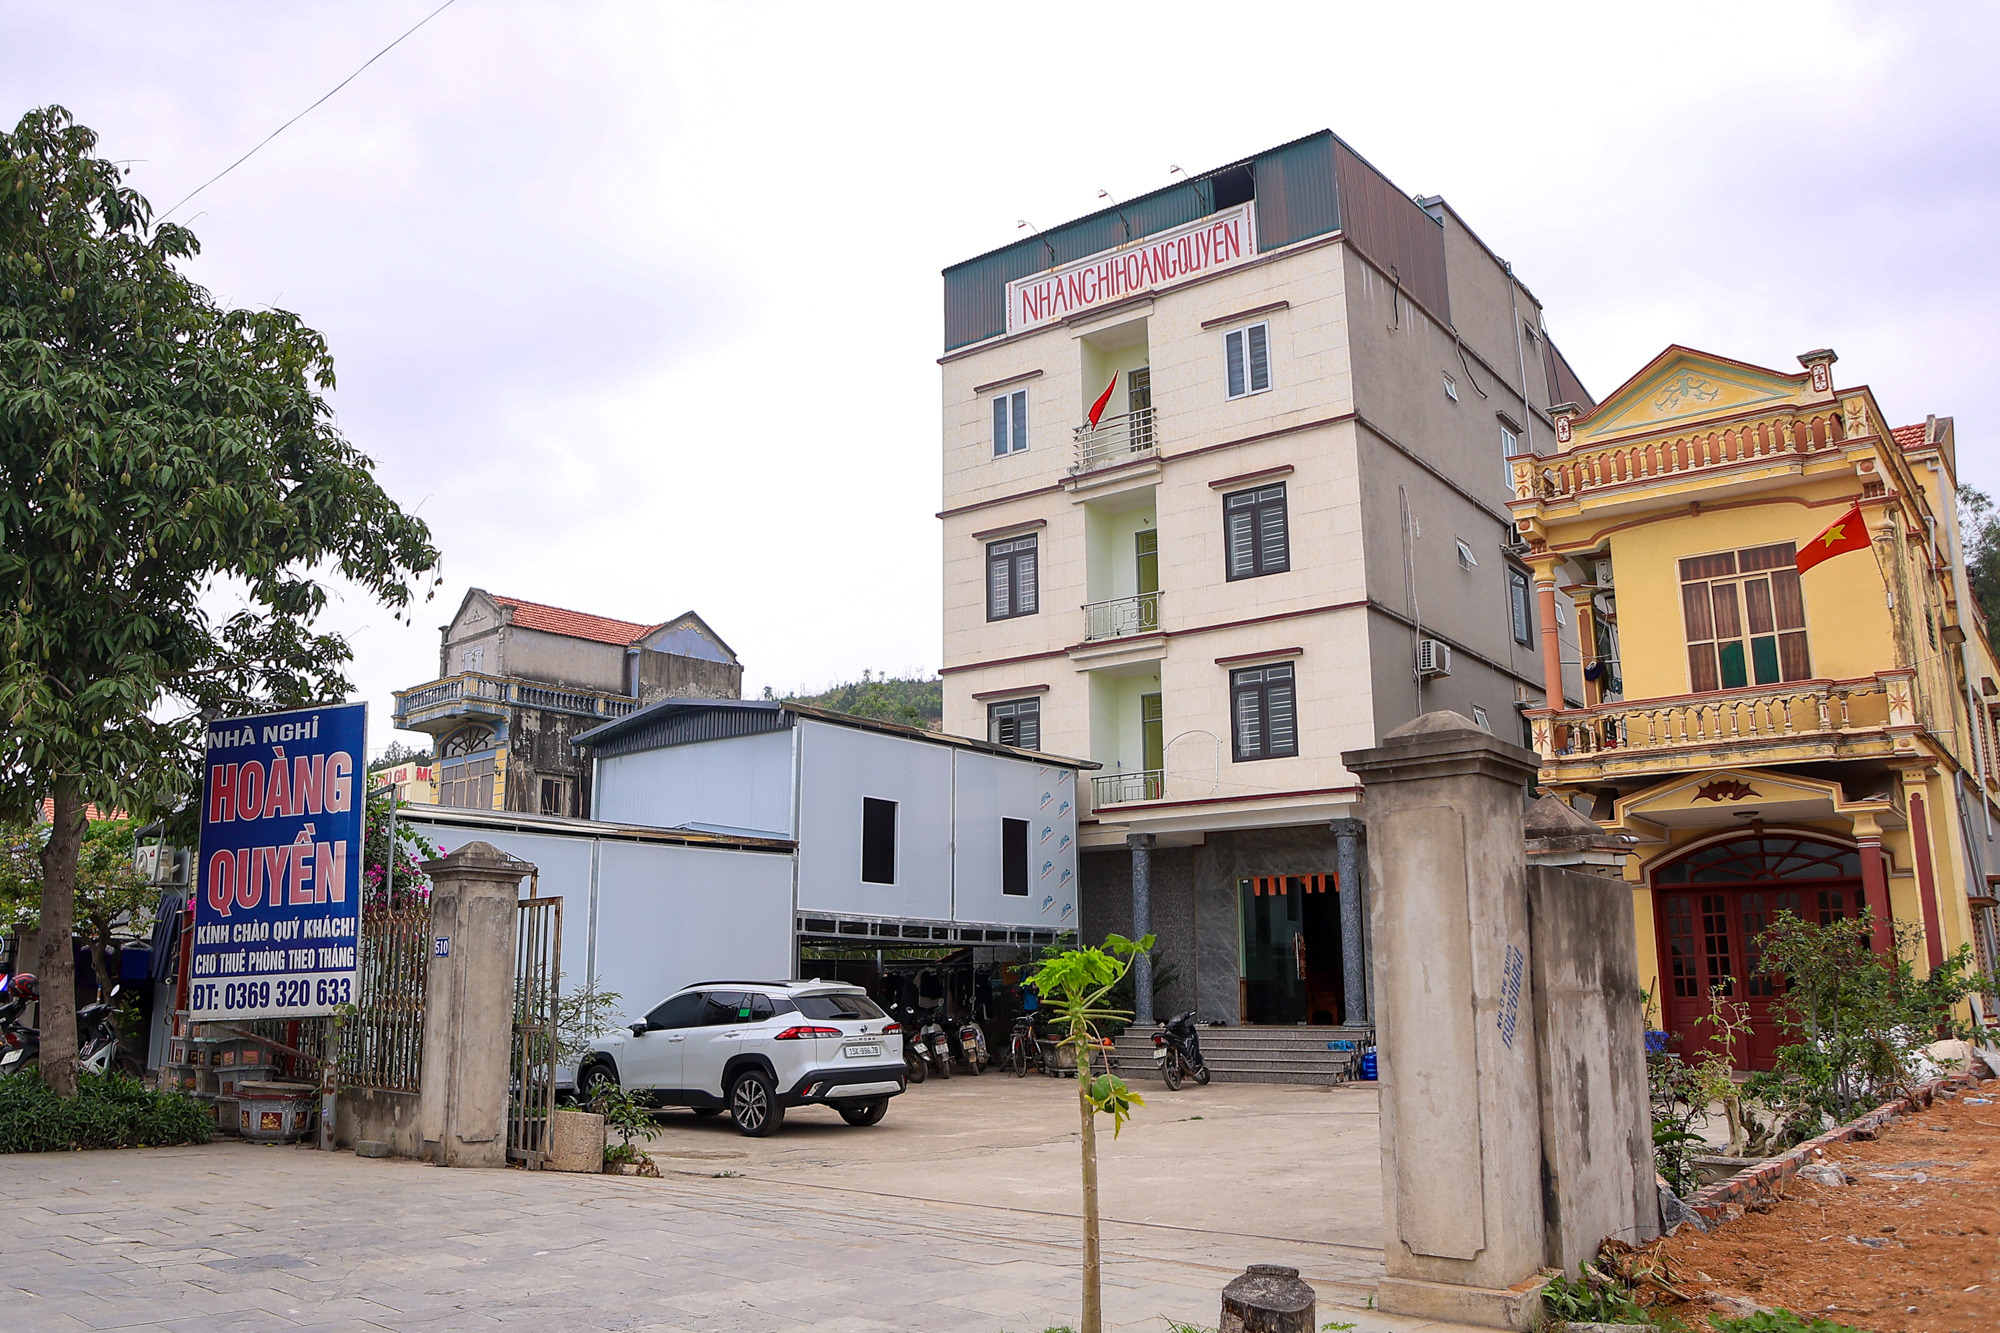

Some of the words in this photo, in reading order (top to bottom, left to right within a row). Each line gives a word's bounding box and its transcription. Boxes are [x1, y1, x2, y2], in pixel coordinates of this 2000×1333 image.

[208, 725, 256, 749] NHÀ
[263, 715, 319, 744] NGHỈ
[209, 745, 353, 823] HOÀNG
[394, 768, 407, 783] GIA
[208, 823, 347, 917] QUYỀN
[197, 922, 230, 944] KÍNH
[233, 919, 270, 942] CHÀO
[273, 916, 300, 942] QUÝ
[303, 914, 355, 939] KHÁCH!
[195, 953, 217, 974] CHO
[220, 948, 246, 973] THUÊ
[248, 946, 285, 972] PHÒNG
[288, 949, 315, 970] THEO
[318, 943, 354, 968] THÁNG
[435, 940, 448, 954] 510
[192, 984, 219, 1011] ĐT:
[225, 981, 270, 1010] 0369
[276, 979, 310, 1007] 320
[317, 977, 351, 1006] 633
